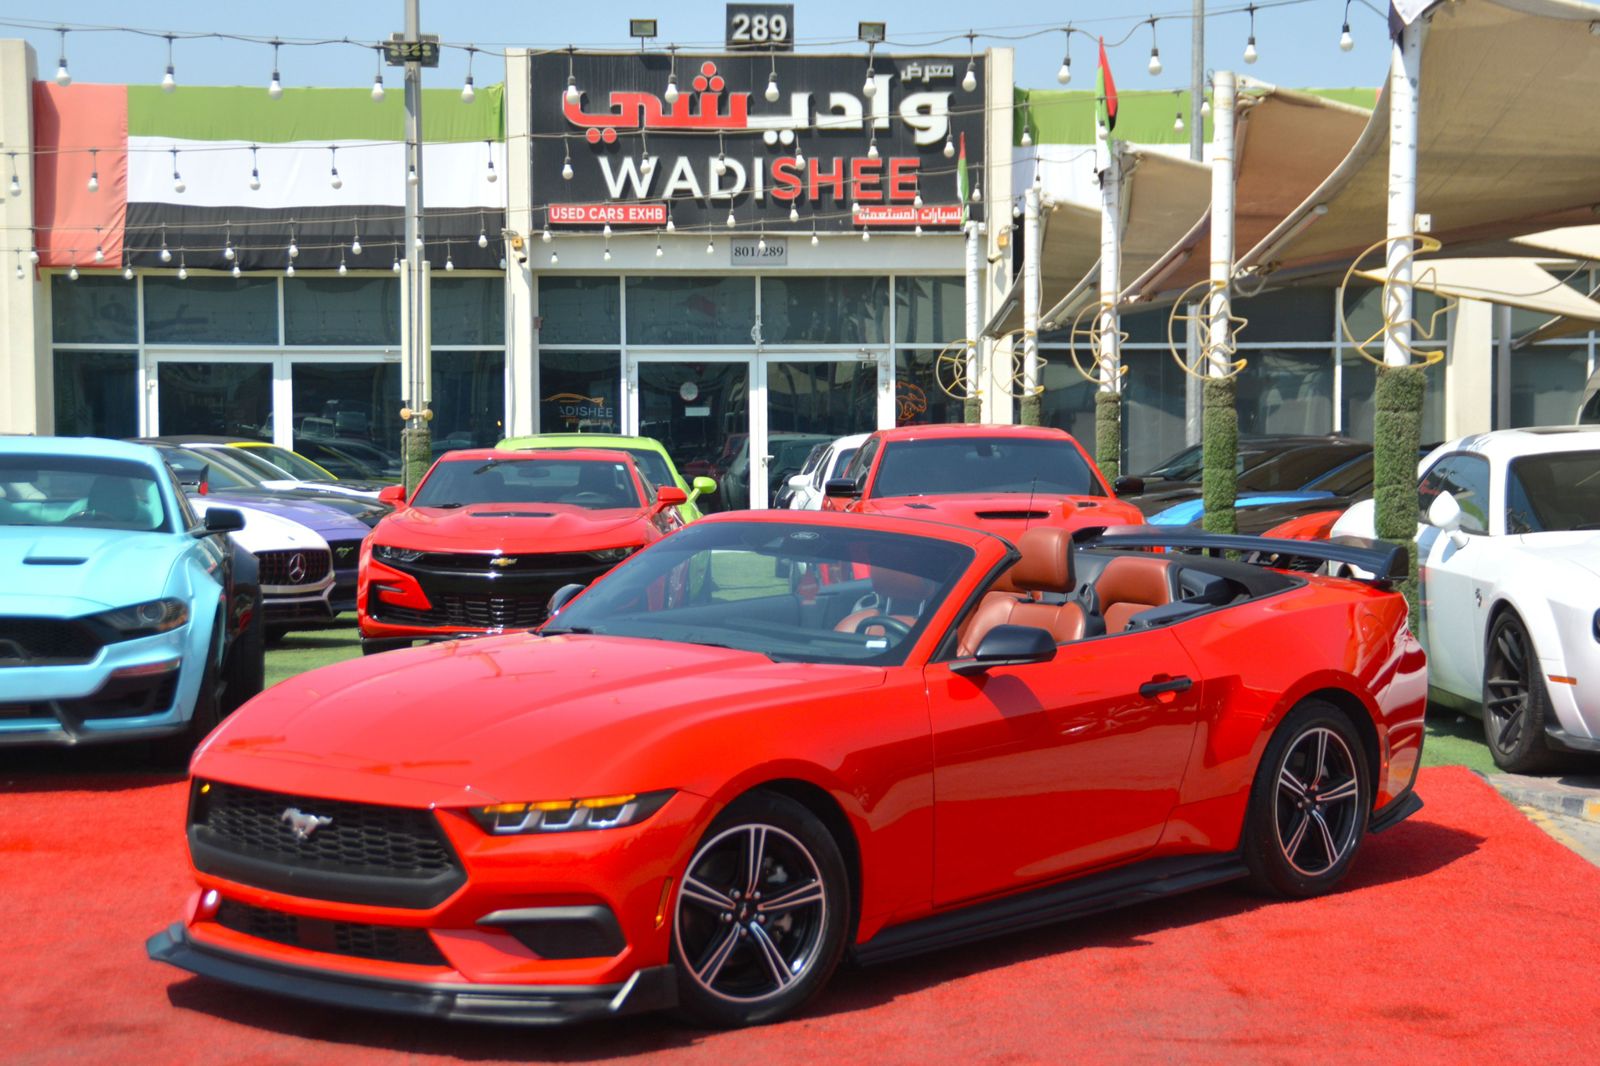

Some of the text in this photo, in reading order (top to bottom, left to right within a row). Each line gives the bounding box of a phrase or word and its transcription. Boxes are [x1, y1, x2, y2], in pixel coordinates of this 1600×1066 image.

[731, 13, 787, 42] 289
[901, 62, 954, 82] معرض
[598, 155, 921, 200] WADISHEE
[551, 207, 664, 220] USED CARS EXHB
[734, 246, 784, 257] 801/289
